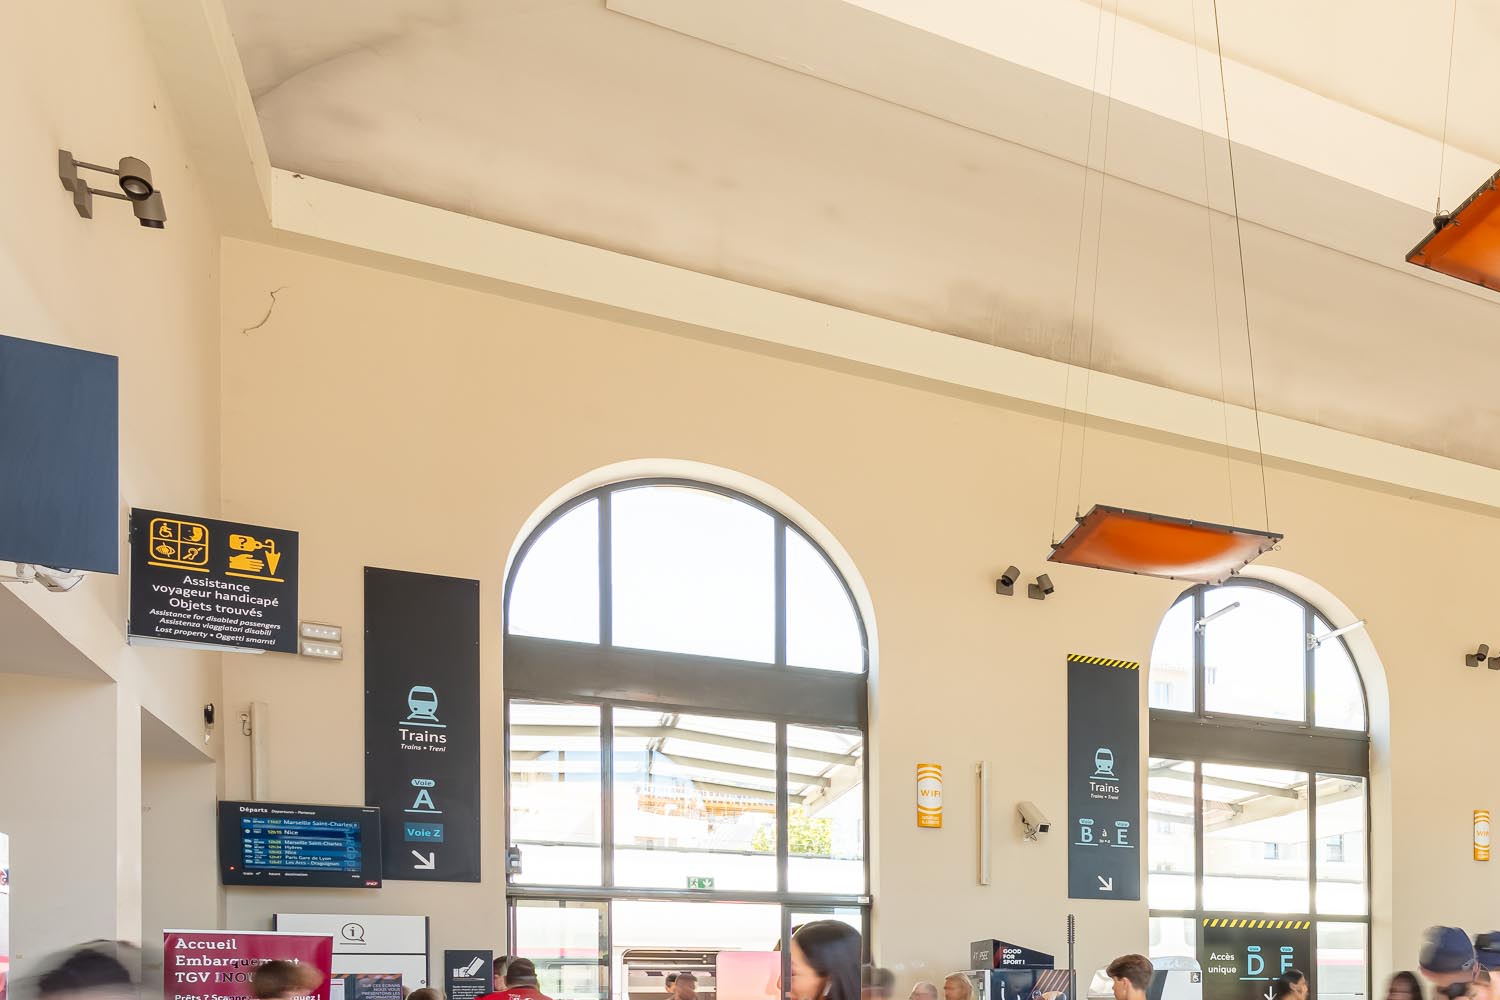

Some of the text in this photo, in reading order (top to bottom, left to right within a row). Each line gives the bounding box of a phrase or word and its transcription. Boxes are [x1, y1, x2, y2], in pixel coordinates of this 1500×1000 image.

[183, 575, 250, 592] Assistance
[152, 584, 279, 607] voyageur handicapé
[169, 598, 263, 618] Objets trouvés
[149, 608, 281, 630] Assistance for disabled passengers
[159, 617, 271, 636] Assistenza viaggiatori disabili
[155, 626, 173, 634] Lost
[173, 629, 208, 639] property
[215, 632, 245, 642] Oggetti
[399, 728, 447, 744] Trains
[400, 743, 422, 751] Trains
[1089, 781, 1120, 793] Trains
[412, 789, 435, 810] A
[239, 806, 268, 814] Départs
[407, 828, 441, 837] Voie Z
[1081, 826, 1093, 842] B
[1117, 829, 1128, 844] E
[175, 938, 237, 950] Accueil
[1210, 952, 1235, 961] Accès
[1247, 954, 1265, 975] D
[175, 972, 253, 983] TGV INO
[1208, 965, 1237, 975] unique
